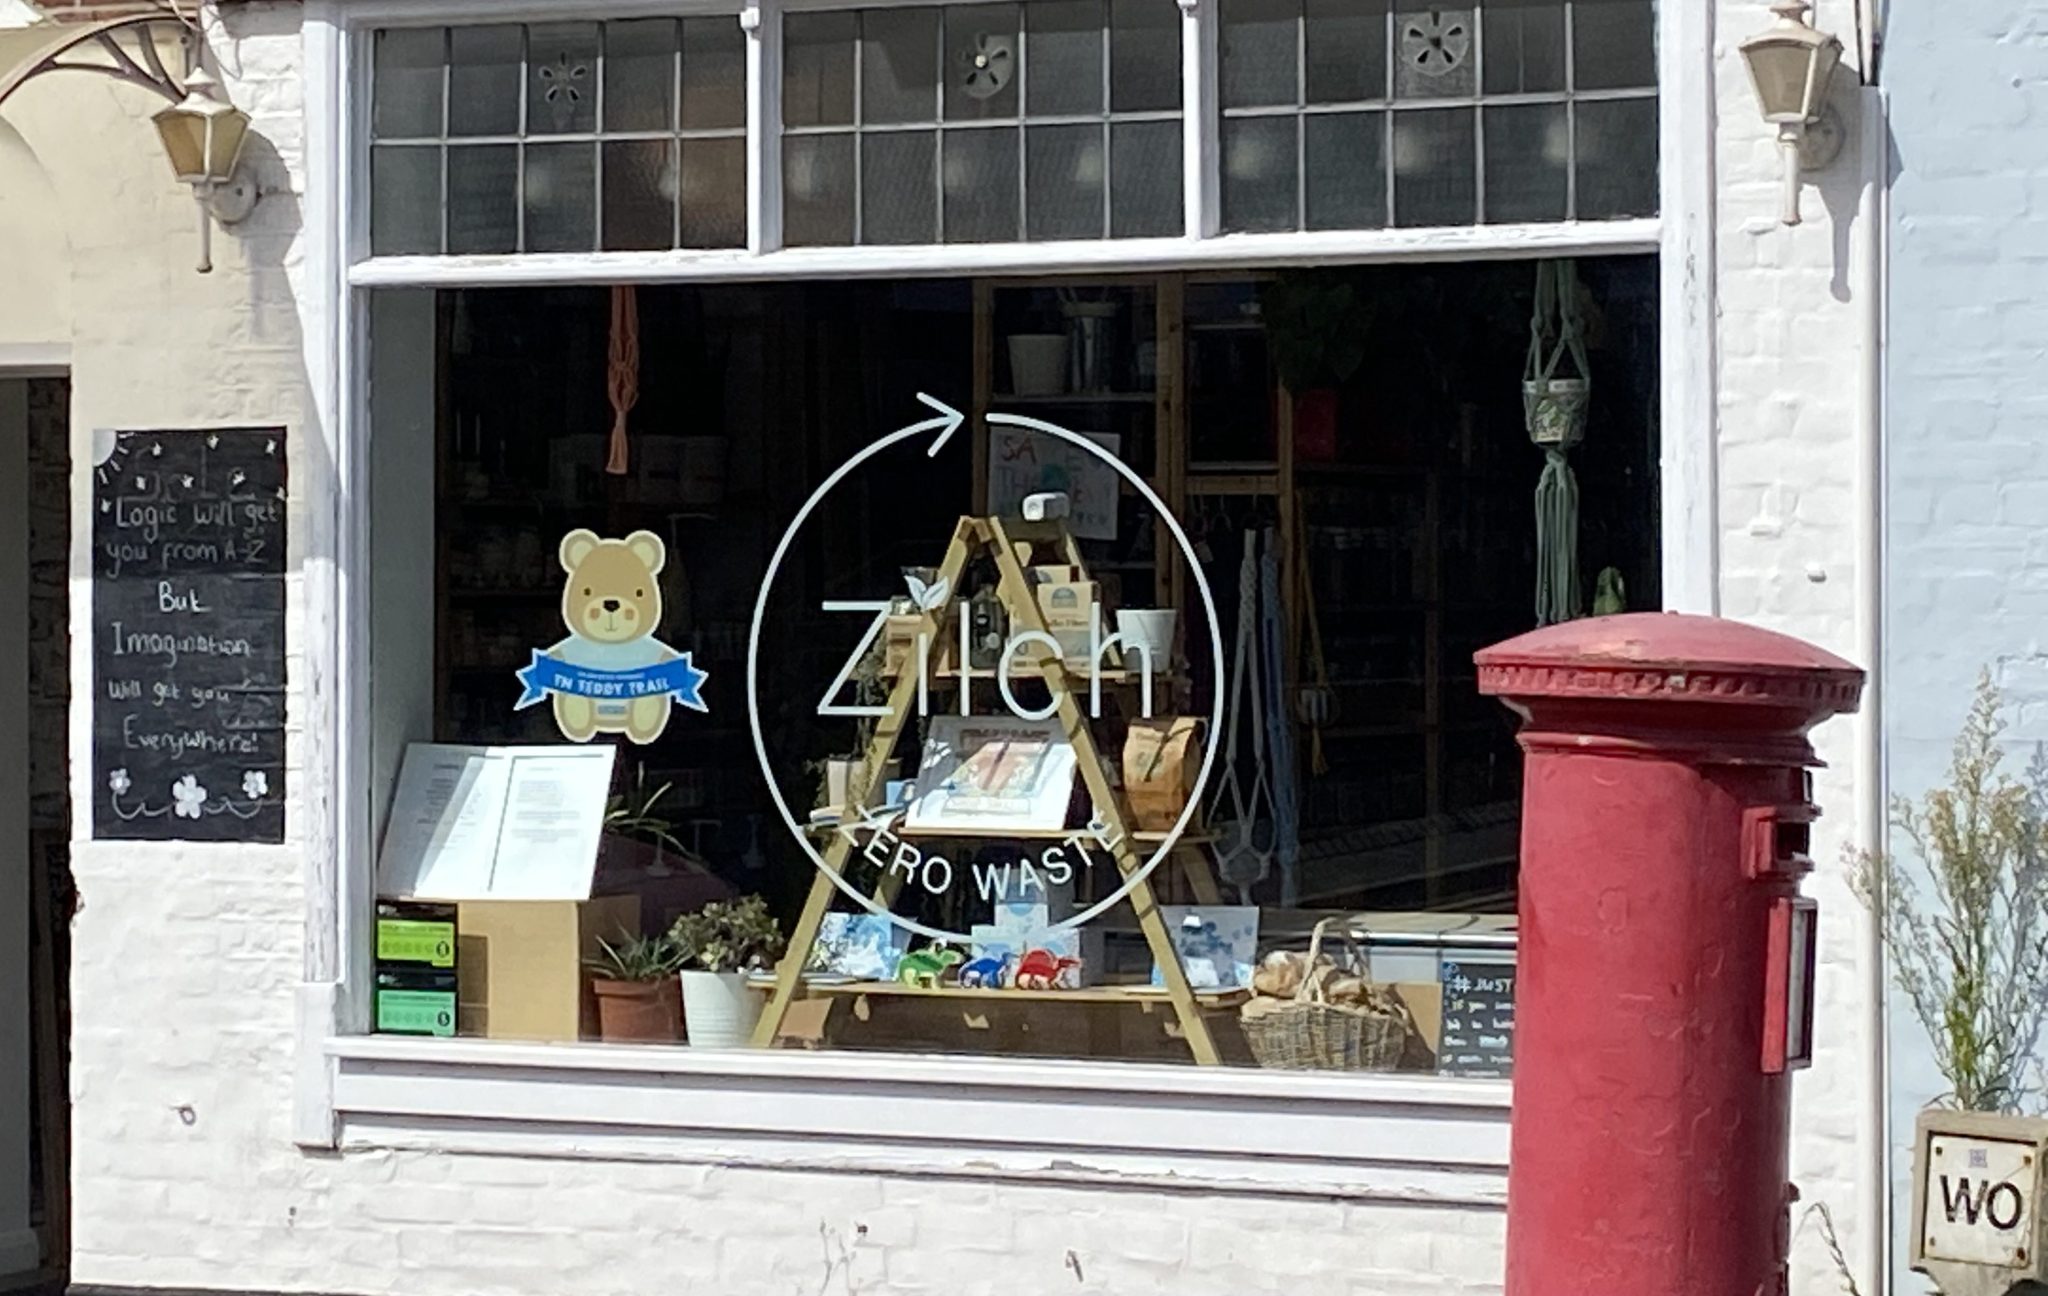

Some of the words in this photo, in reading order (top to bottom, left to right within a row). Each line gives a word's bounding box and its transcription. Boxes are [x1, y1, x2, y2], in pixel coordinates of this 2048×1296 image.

[116, 497, 177, 544] Logic
[244, 503, 278, 534] get
[105, 542, 148, 579] you
[161, 542, 218, 570] from
[158, 580, 212, 612] But
[111, 621, 251, 668] Imagination
[817, 600, 1152, 720] Zilch
[152, 681, 180, 707] get
[191, 688, 230, 708] you
[554, 673, 573, 690] TN
[577, 679, 624, 696] TEDDY
[628, 677, 671, 696] TRAIL
[973, 810, 1125, 900] WASTE
[1939, 1174, 2024, 1231] WO
